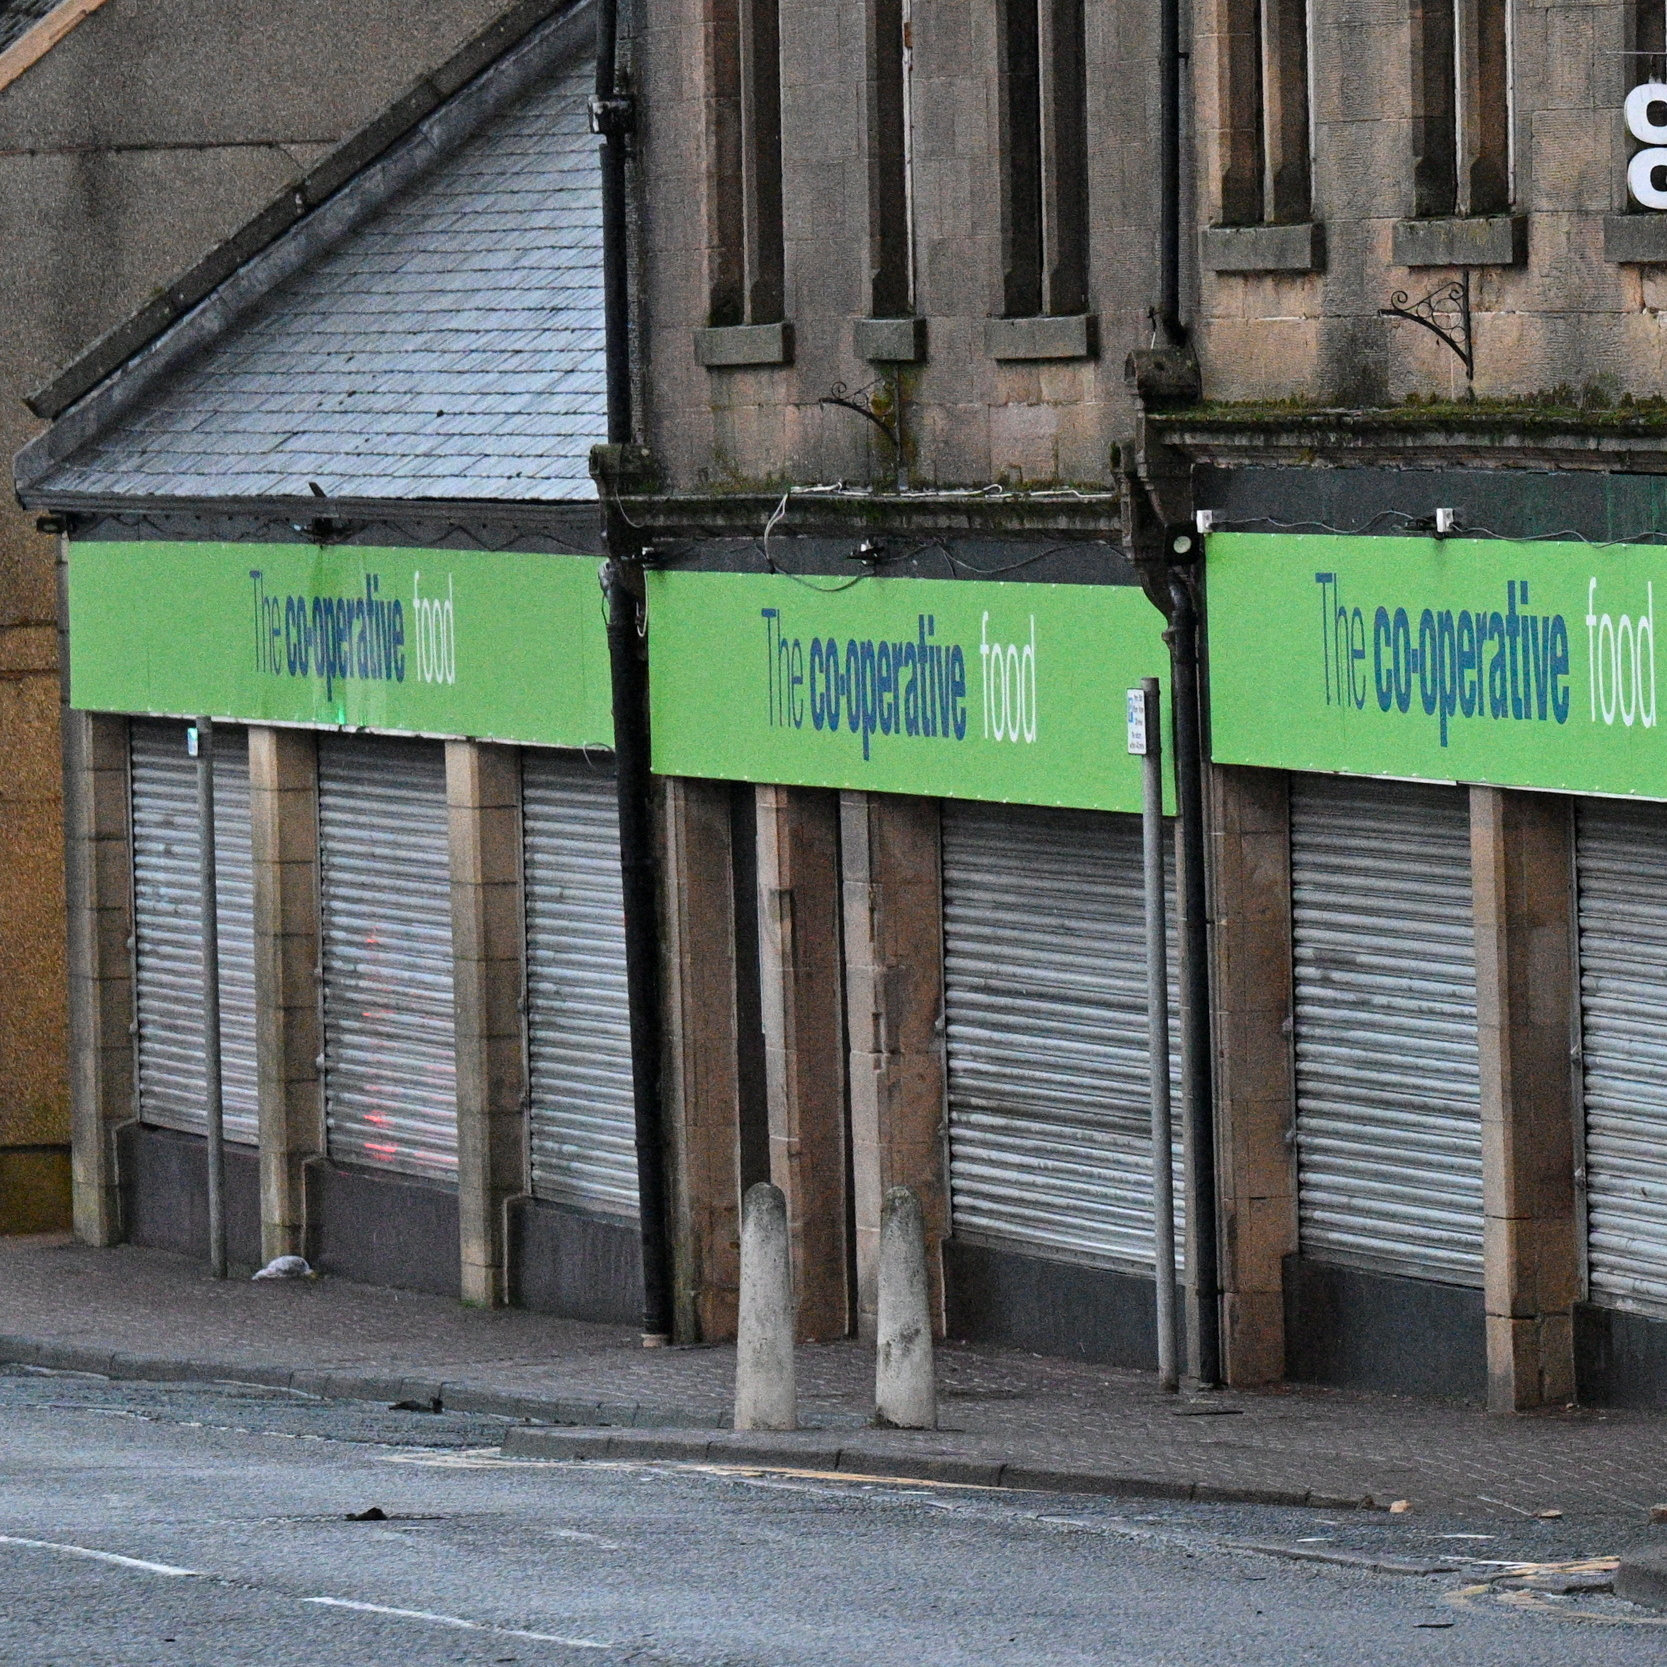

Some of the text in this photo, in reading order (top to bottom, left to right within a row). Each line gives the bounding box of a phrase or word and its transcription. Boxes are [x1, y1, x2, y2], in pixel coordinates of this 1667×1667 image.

[250, 569, 456, 700] The co-operative food
[761, 607, 804, 729] The
[809, 614, 967, 761] co-operative
[979, 609, 1037, 744] food
[1314, 572, 1658, 748] The co-operative food
